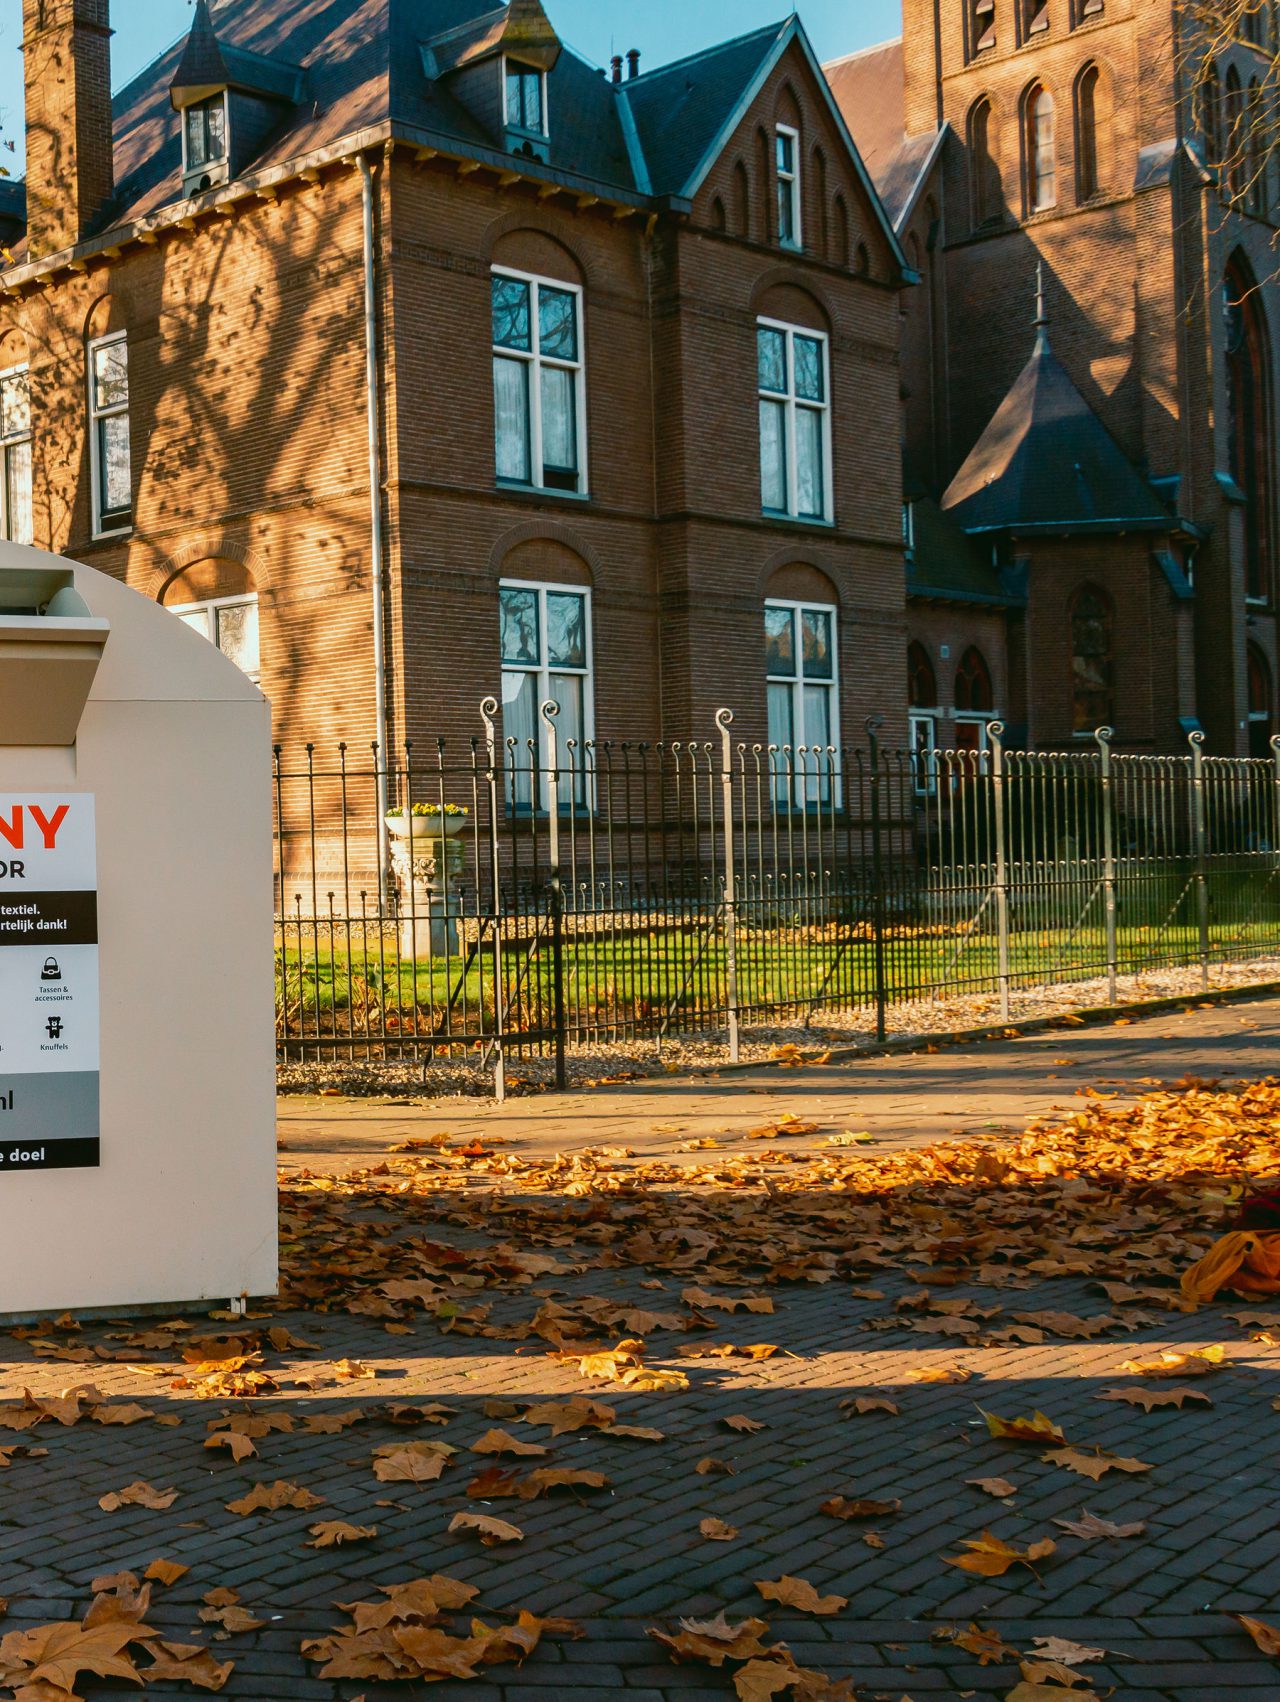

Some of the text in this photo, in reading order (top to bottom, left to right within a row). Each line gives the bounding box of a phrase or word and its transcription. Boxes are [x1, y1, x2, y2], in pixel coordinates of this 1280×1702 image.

[1, 903, 41, 915] textiel.
[36, 918, 68, 930] dank!
[40, 1043, 68, 1051] Knuffels
[9, 1147, 45, 1162] doel
